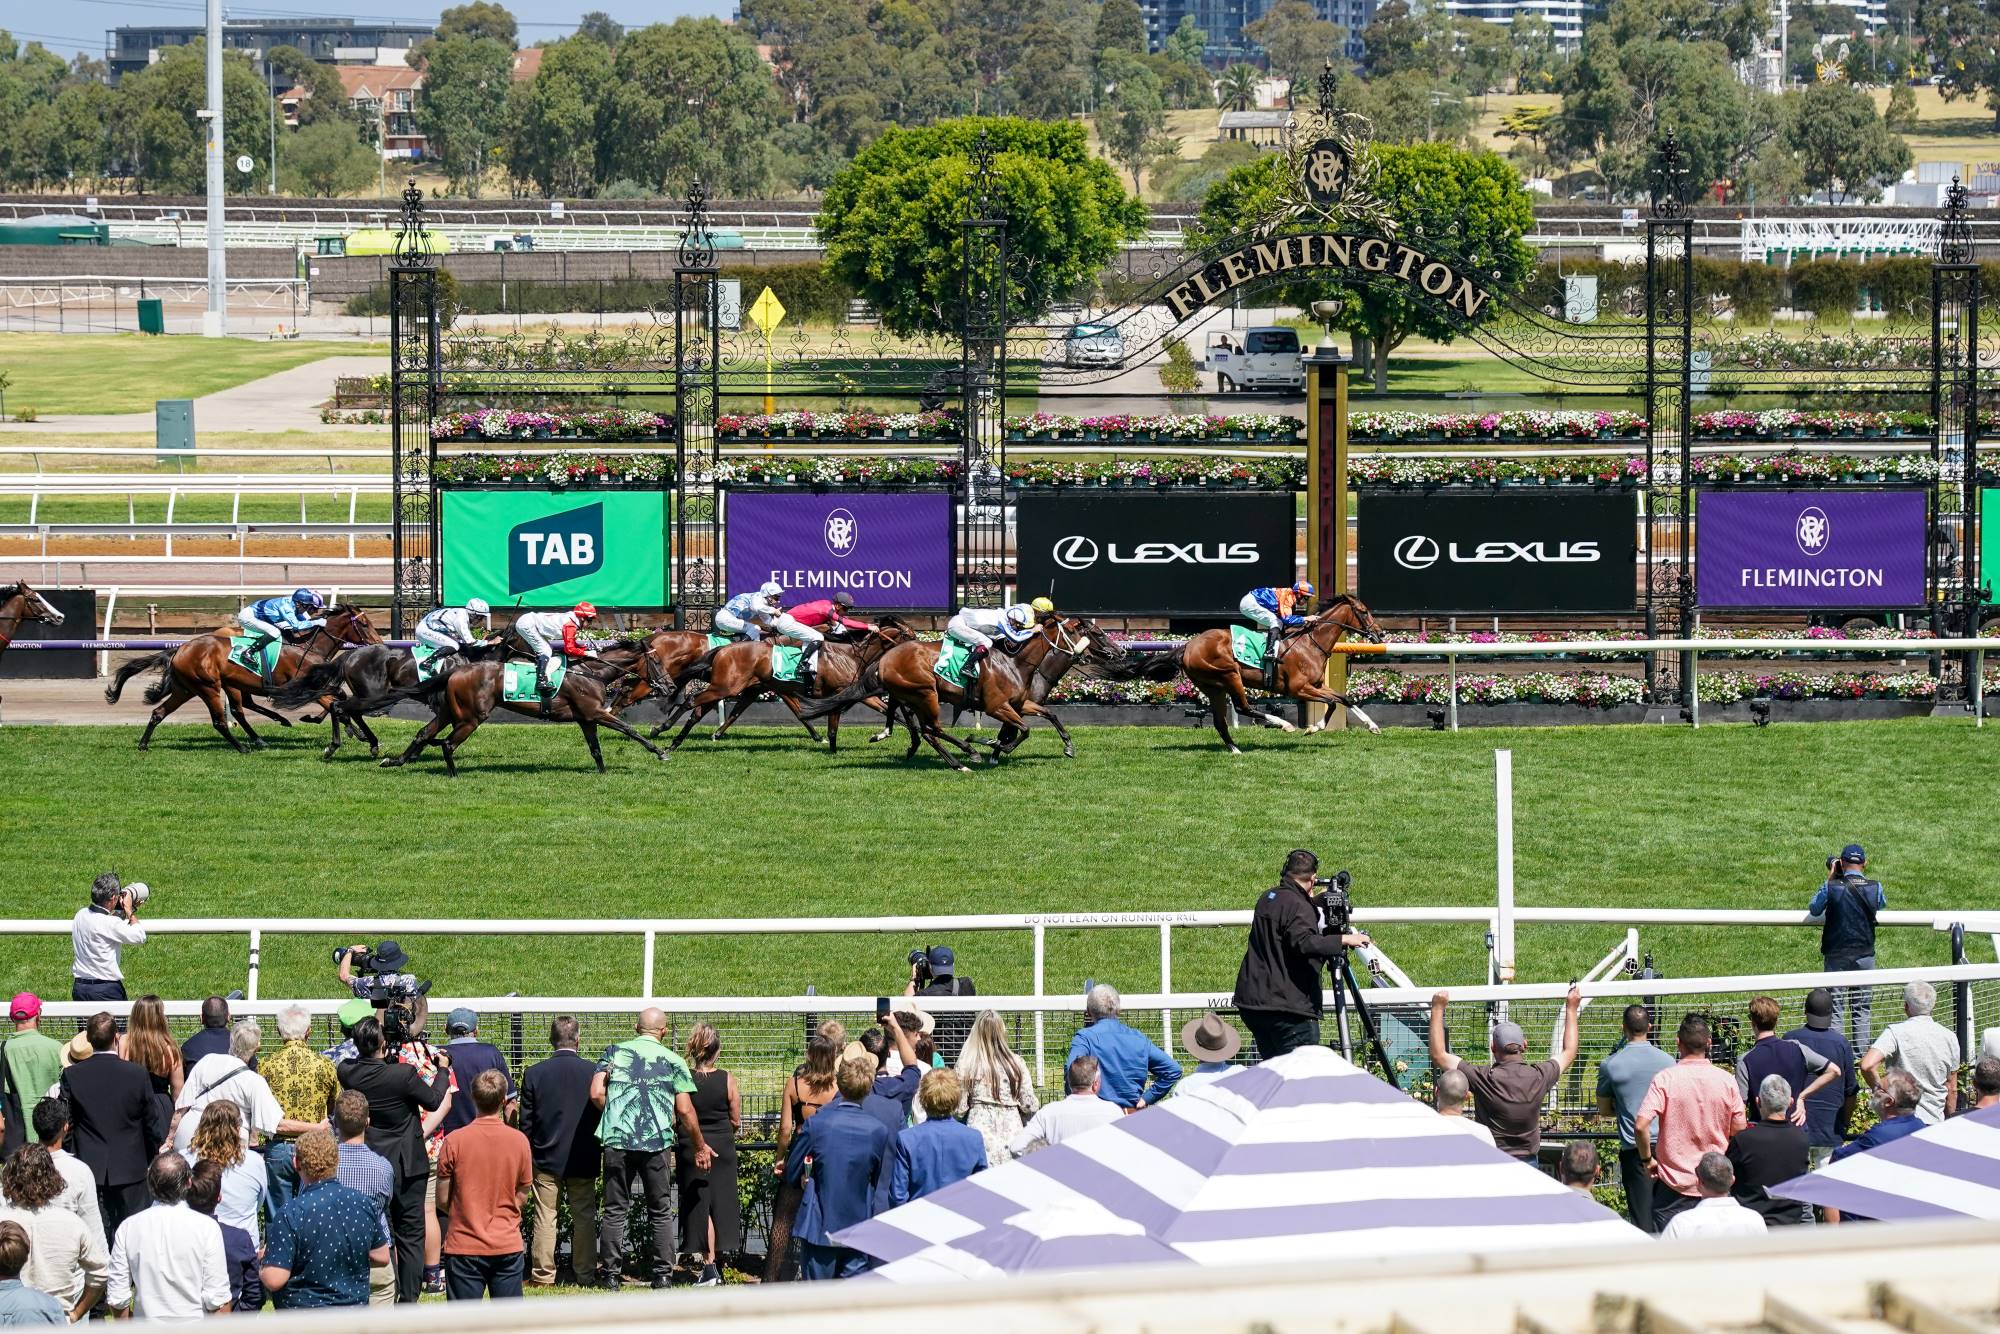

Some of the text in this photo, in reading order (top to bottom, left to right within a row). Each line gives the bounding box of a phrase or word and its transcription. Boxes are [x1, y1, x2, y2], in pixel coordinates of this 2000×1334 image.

[1165, 235, 1490, 320] FLEMINGTON
[519, 533, 595, 565] TAB
[1107, 543, 1260, 564] LEXUS
[1449, 542, 1601, 563] LEXUS
[771, 570, 911, 589] FLEMINGTON
[1741, 568, 1883, 587] FLEMINGTON
[1024, 915, 1040, 924] DO
[1044, 915, 1065, 923] NOT
[1069, 914, 1098, 923] LEAN
[1101, 914, 1118, 923] ON
[1121, 913, 1173, 922] RUNNING
